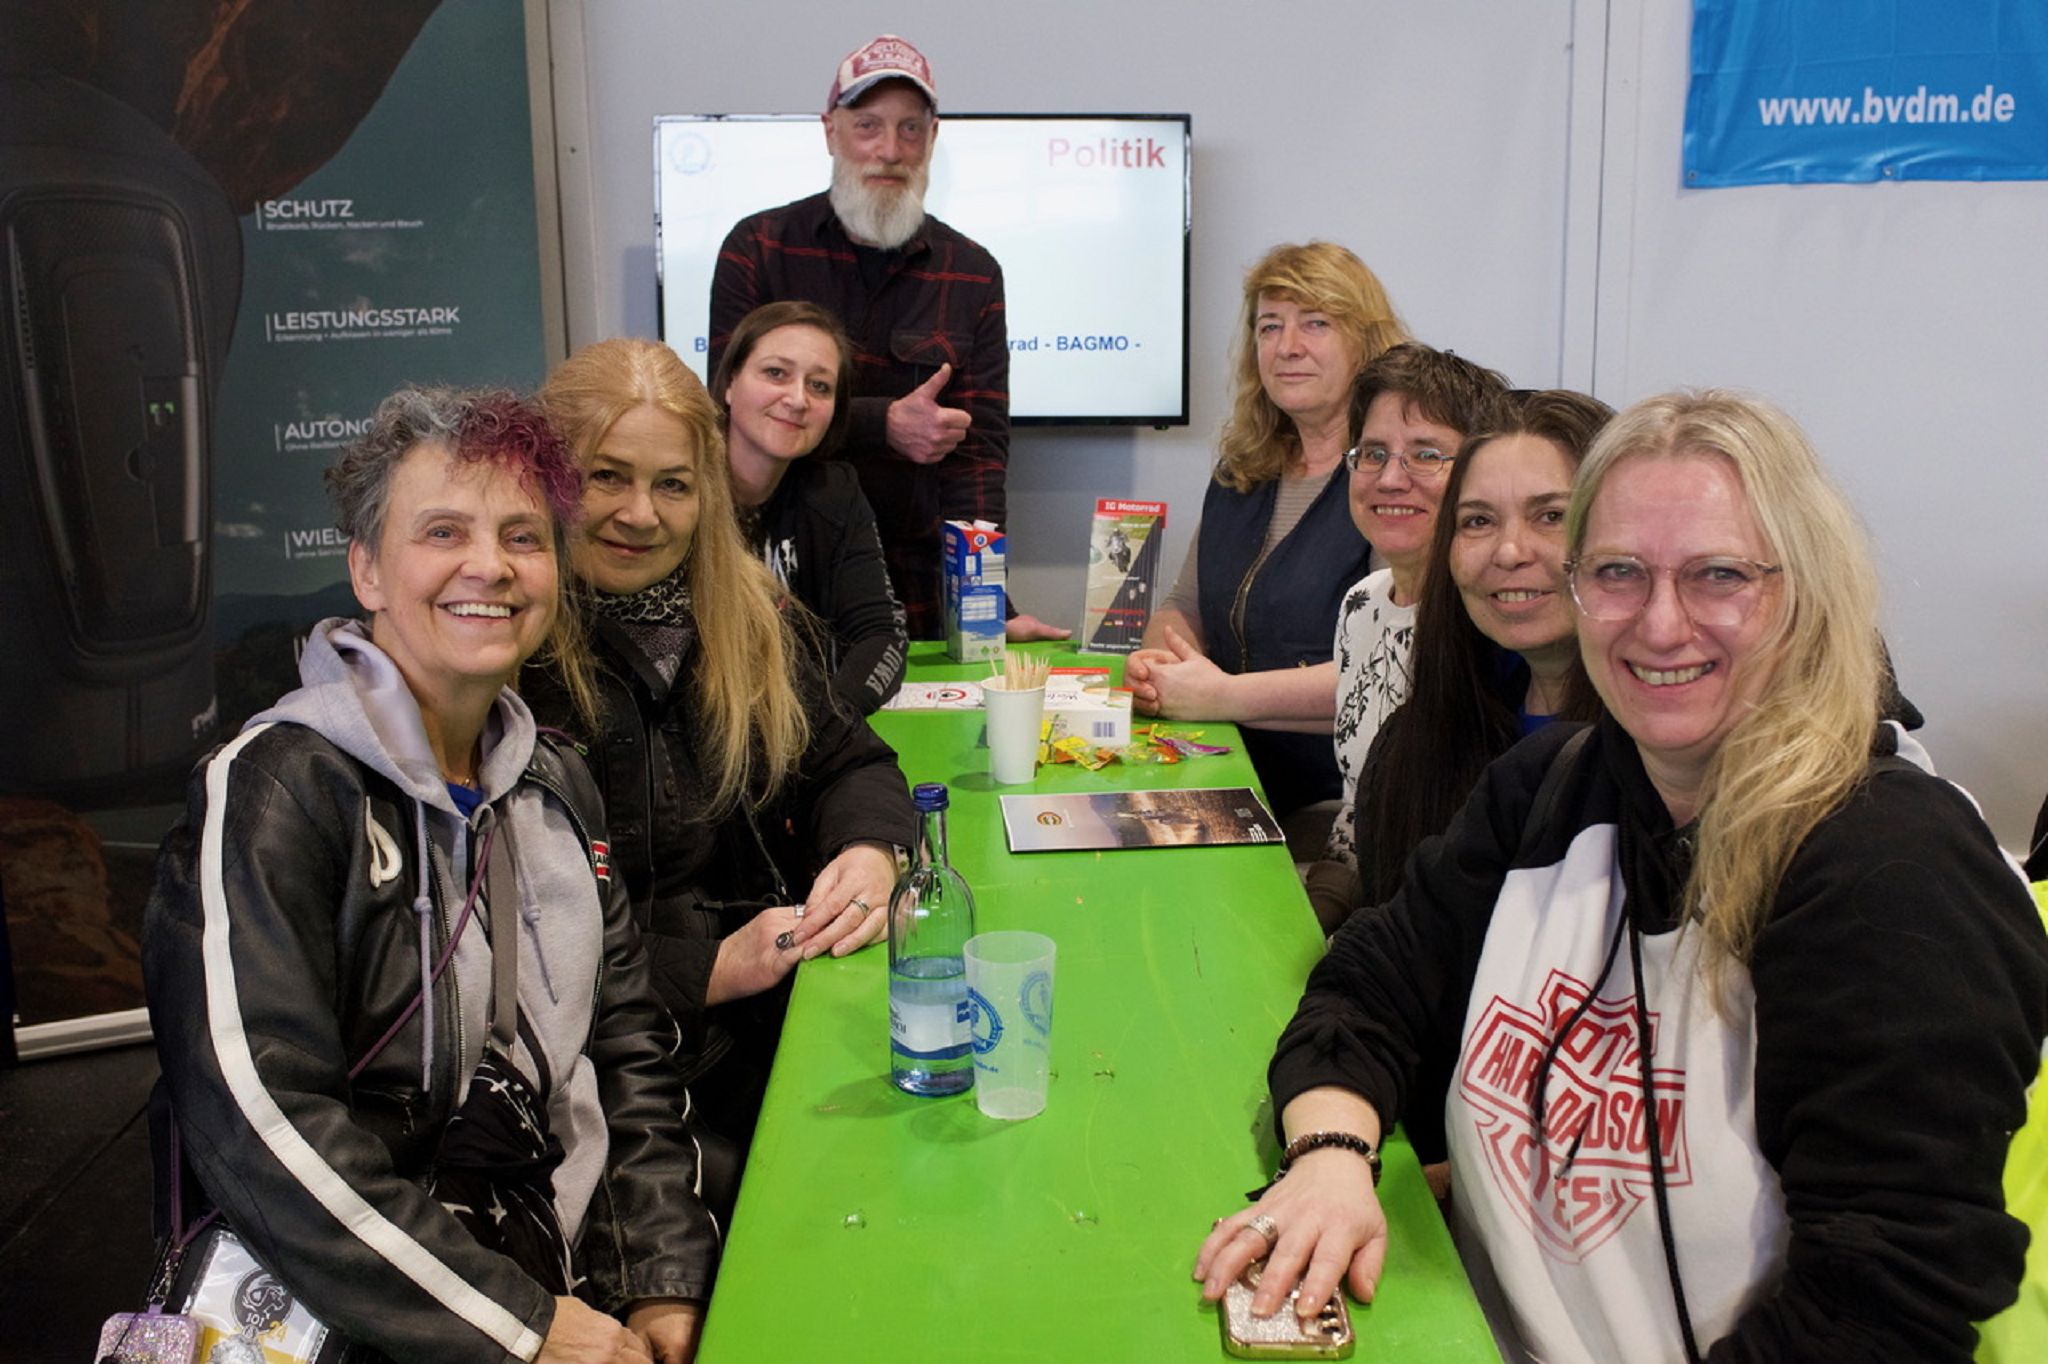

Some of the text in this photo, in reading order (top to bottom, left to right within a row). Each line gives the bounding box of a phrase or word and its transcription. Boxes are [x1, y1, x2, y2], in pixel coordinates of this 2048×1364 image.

[1758, 85, 2016, 126] www.bvdm.de
[1048, 138, 1165, 168] Politik
[264, 200, 354, 218] SCHUTZ
[273, 307, 460, 331] LEISTUNGSSTARK
[1056, 335, 1129, 351] BAGMO
